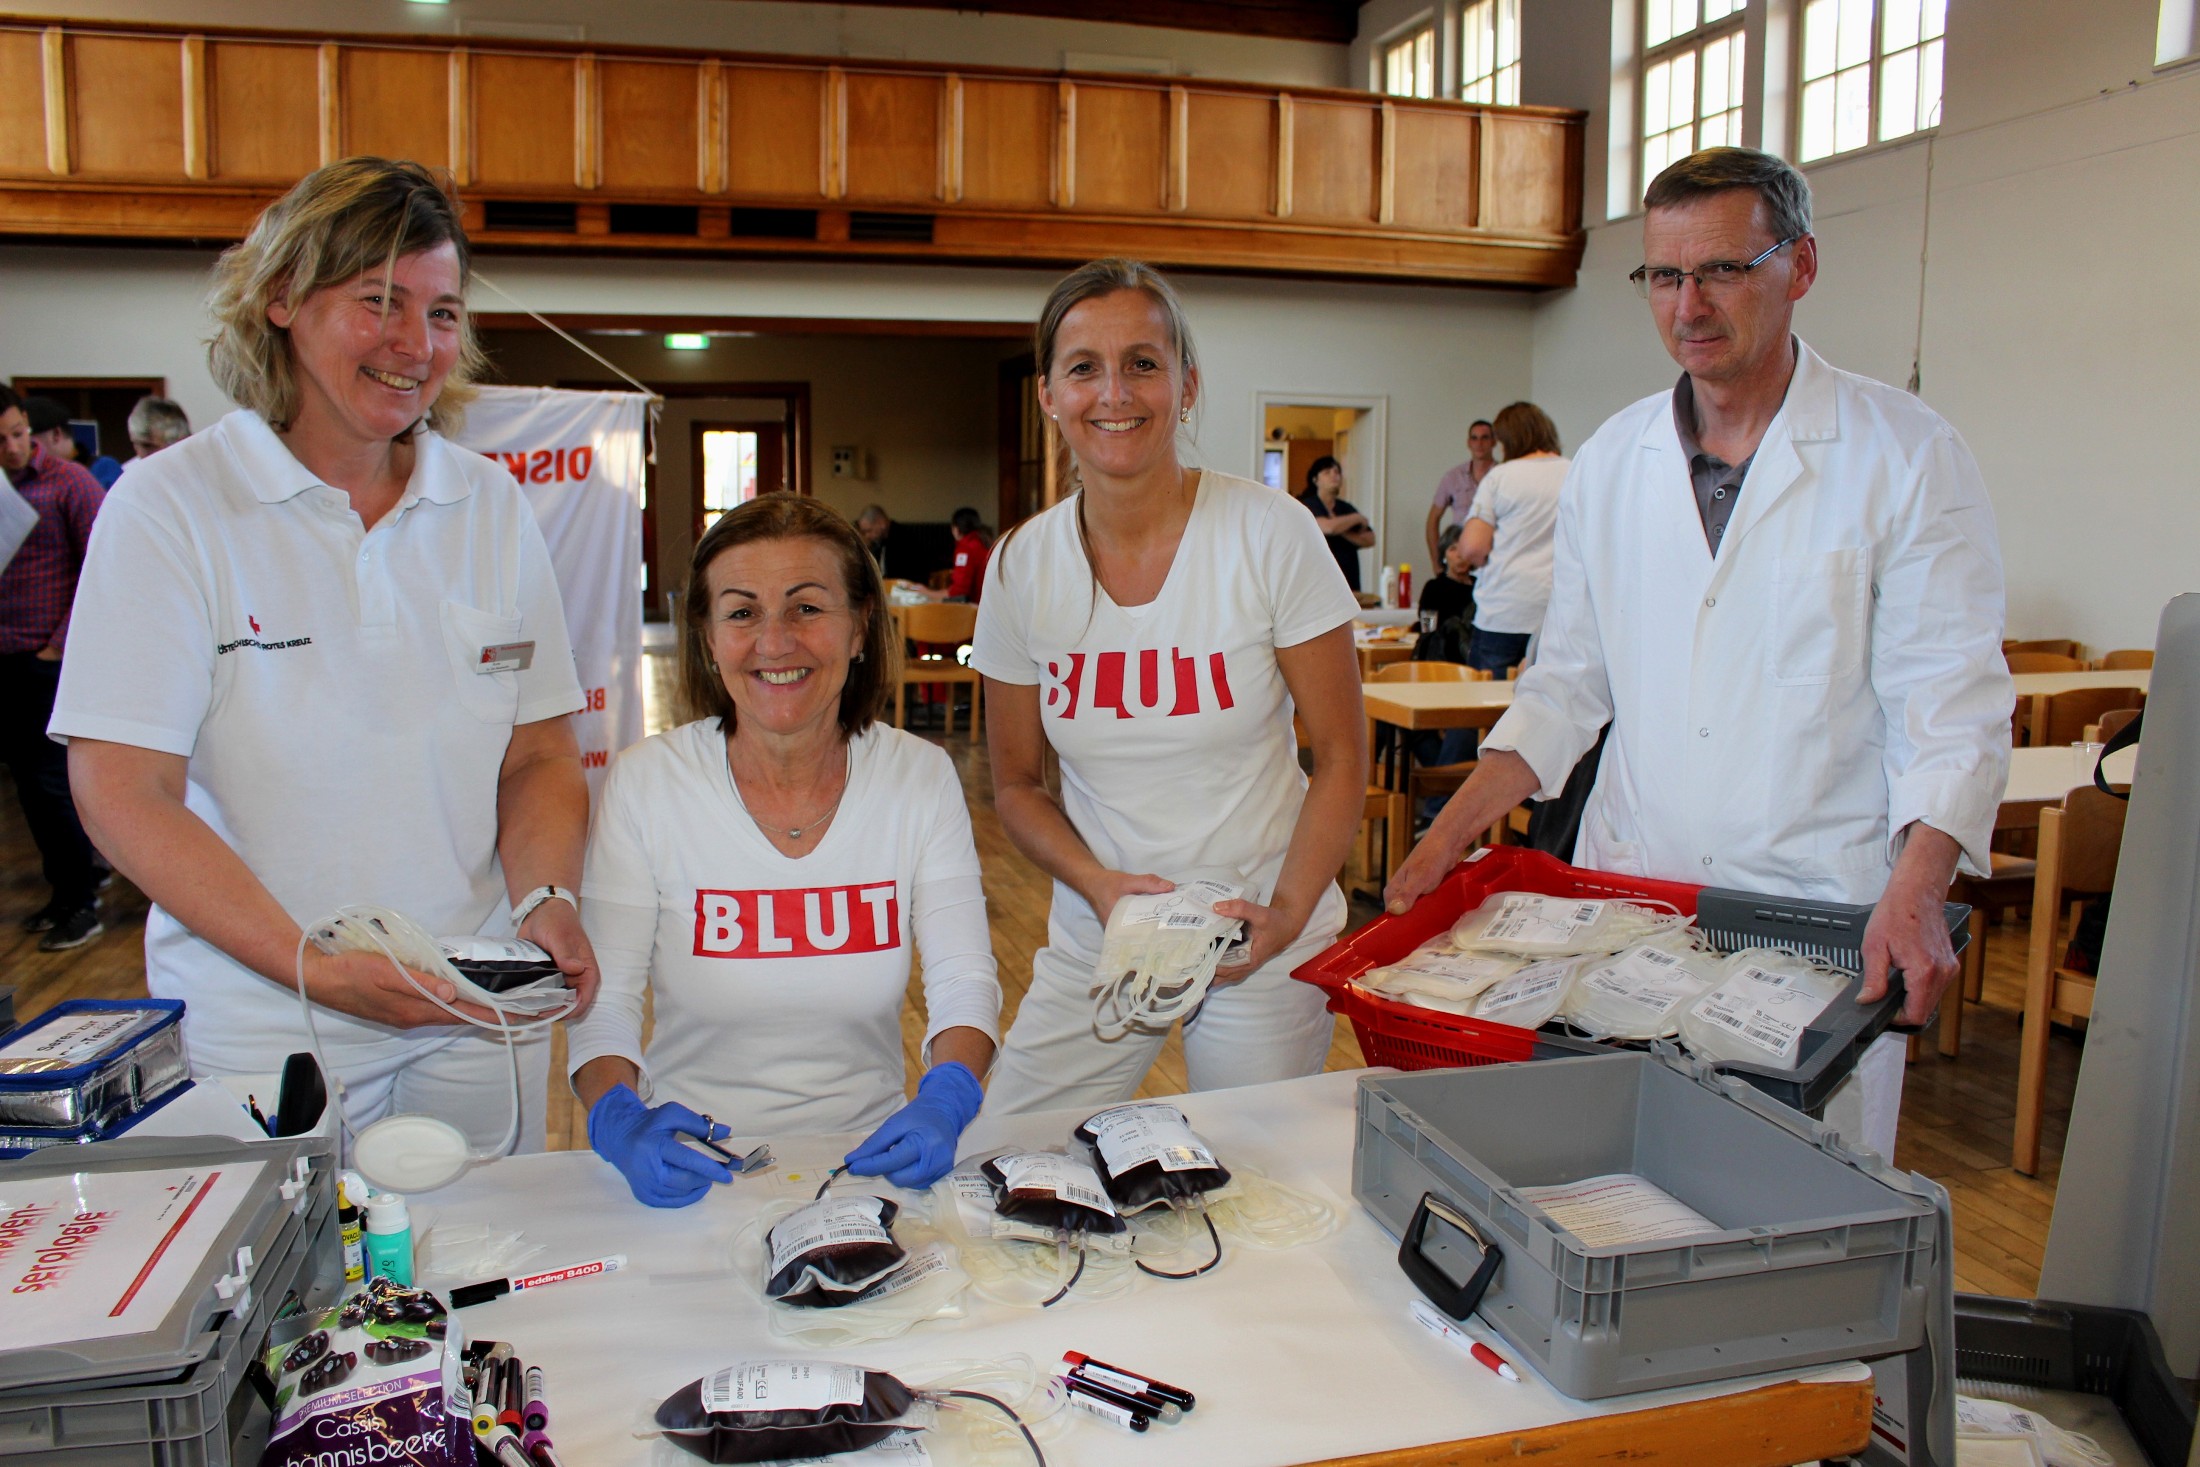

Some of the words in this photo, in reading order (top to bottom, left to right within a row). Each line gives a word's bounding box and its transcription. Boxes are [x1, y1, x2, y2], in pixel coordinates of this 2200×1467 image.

[286, 637, 312, 649] KREUZ
[702, 882, 897, 953] BLUT
[12, 1210, 112, 1294] serologie
[527, 1272, 564, 1287] edding
[566, 1264, 600, 1278] 8400
[299, 1393, 343, 1420] PREMIUM
[344, 1379, 403, 1402] SELECTION
[316, 1413, 381, 1439] Cassis
